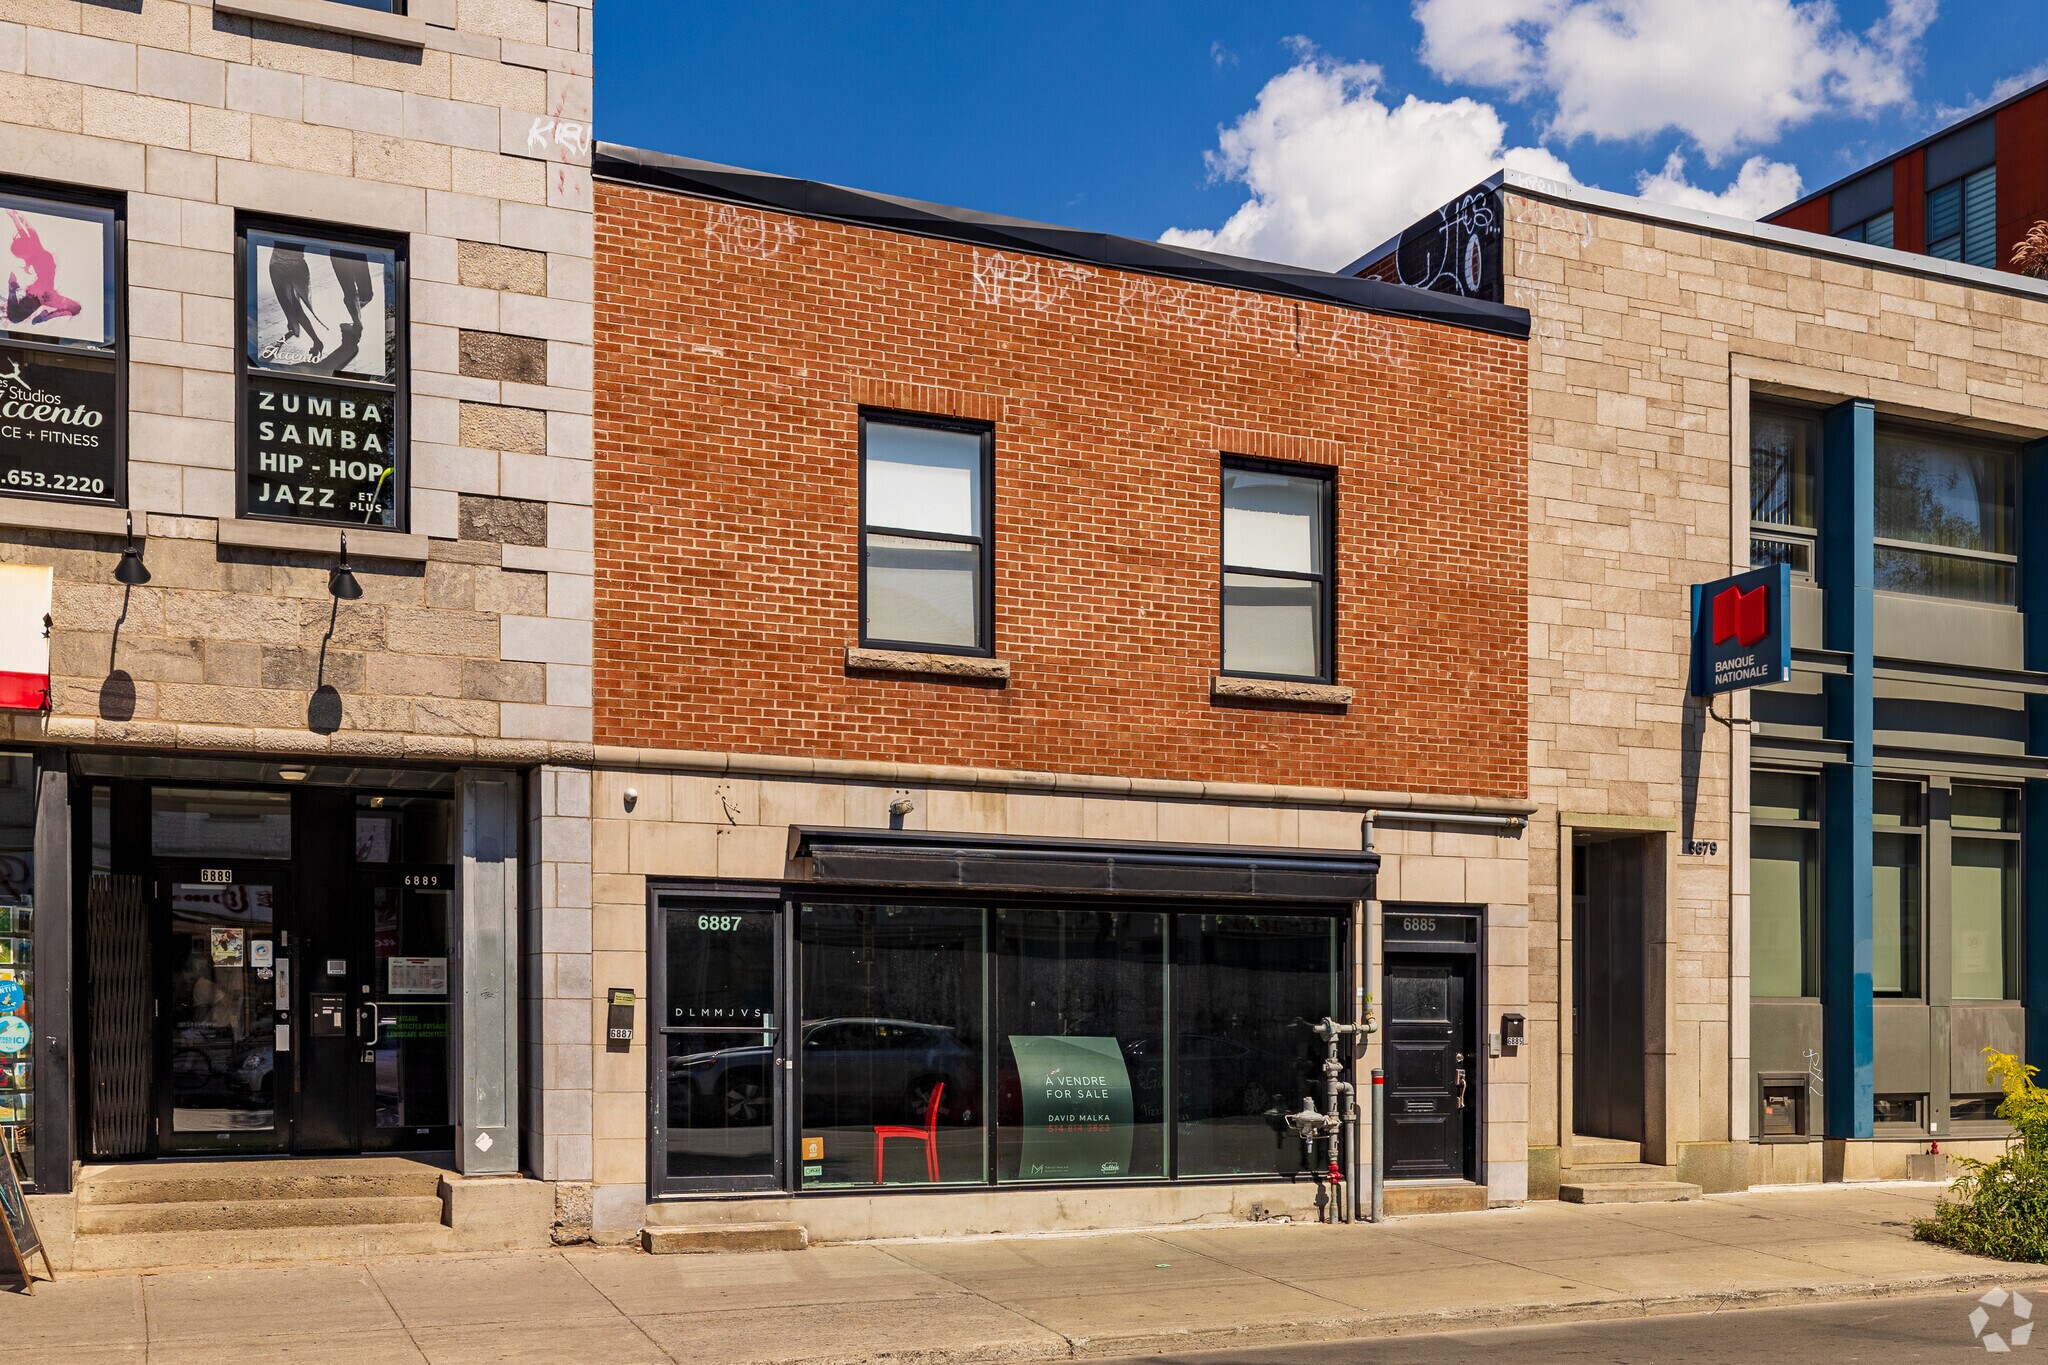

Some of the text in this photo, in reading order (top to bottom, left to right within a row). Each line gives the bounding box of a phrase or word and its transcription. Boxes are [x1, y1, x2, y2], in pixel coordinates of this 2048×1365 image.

[9, 386, 62, 405] Studios
[0, 391, 103, 428] ccento
[259, 391, 382, 423] ZUMBA
[40, 429, 99, 447] FITNESS
[259, 421, 383, 453] SAMBA
[259, 483, 335, 508] JAZZ
[358, 492, 374, 501] ET
[350, 502, 382, 513] PLUS
[1715, 654, 1755, 673] BANQUE
[1715, 664, 1768, 685] NATIONALE
[202, 869, 232, 882] 6889
[404, 875, 438, 886] 6889
[698, 915, 742, 931] 6887
[1403, 917, 1436, 931] 6885
[13, 1036, 25, 1044] ICI
[610, 1029, 632, 1038] 6887
[1057, 1076, 1107, 1086] VENDRE
[1046, 1089, 1109, 1099] FOR SALE
[1048, 1114, 1076, 1122] DAVID
